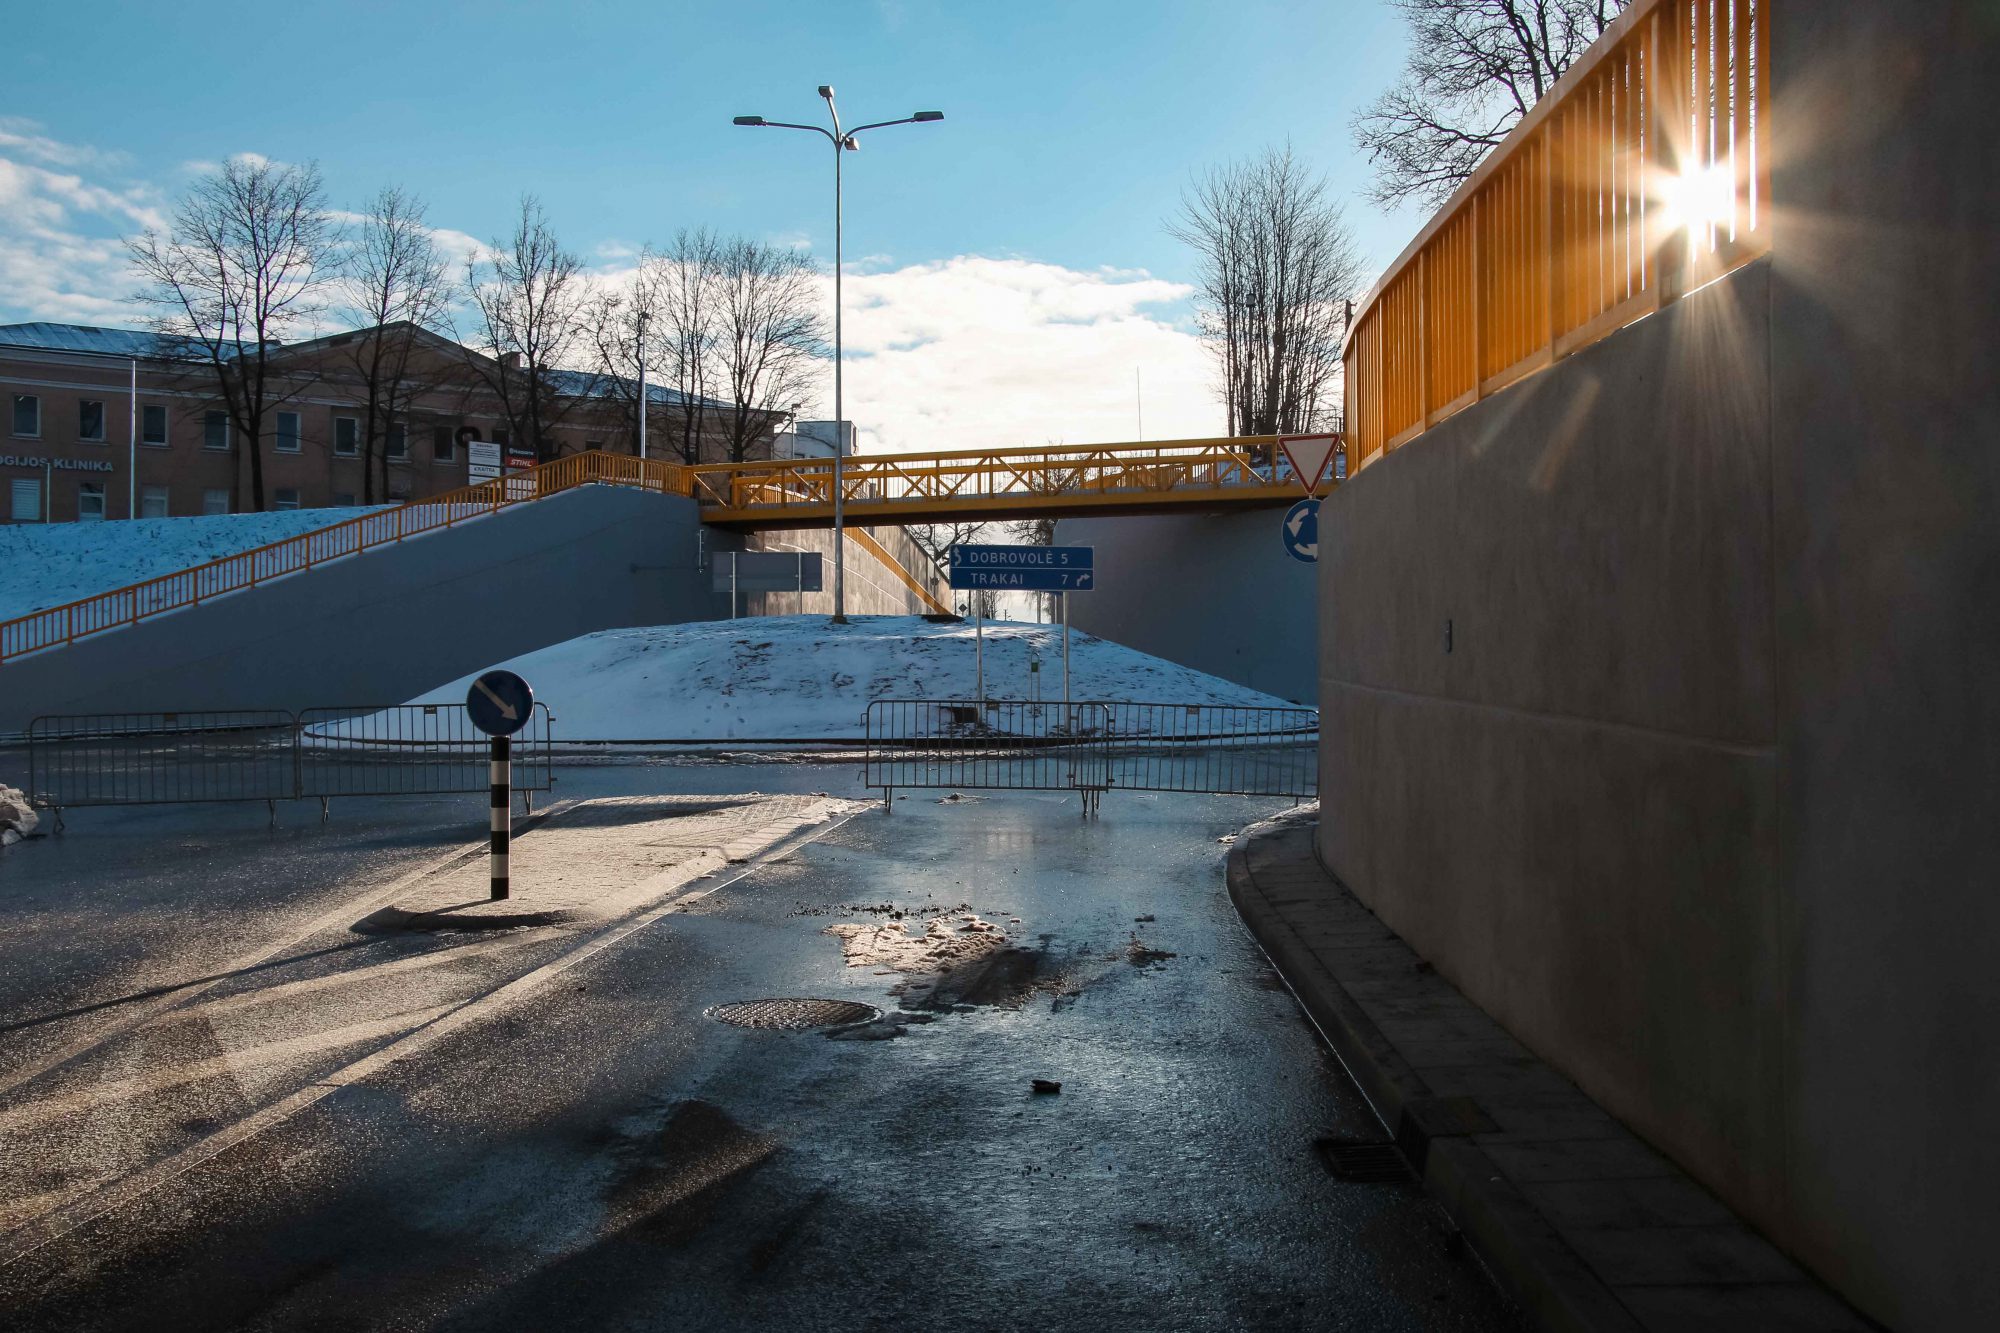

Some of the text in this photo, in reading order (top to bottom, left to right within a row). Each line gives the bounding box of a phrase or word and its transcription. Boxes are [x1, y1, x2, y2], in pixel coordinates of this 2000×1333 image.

[54, 458, 113, 471] KLINIKA
[511, 459, 532, 467] STIHL
[970, 550, 1069, 565] DOBROVOLĖ 5
[970, 573, 1069, 585] TRAKAI 7
